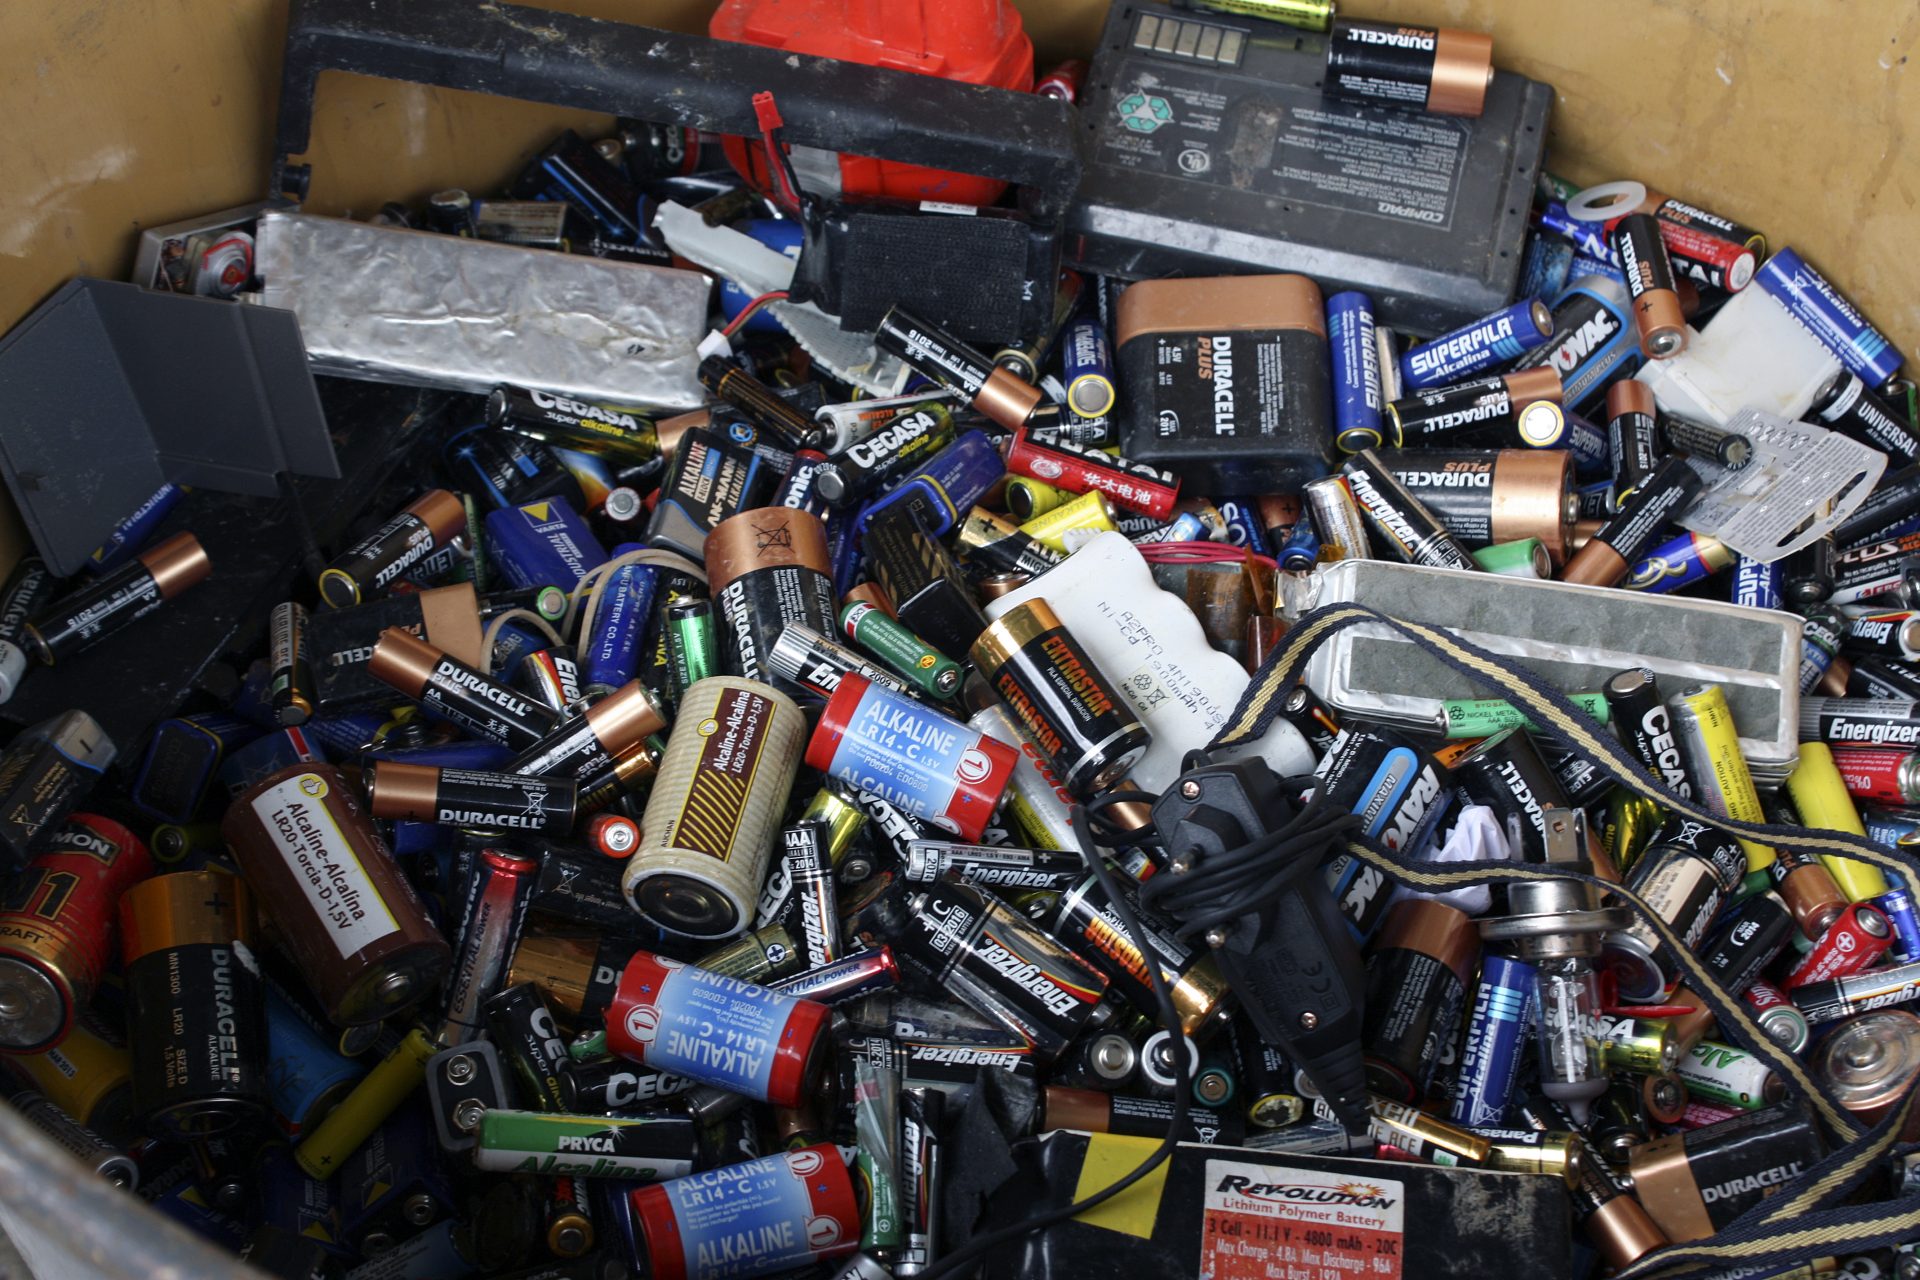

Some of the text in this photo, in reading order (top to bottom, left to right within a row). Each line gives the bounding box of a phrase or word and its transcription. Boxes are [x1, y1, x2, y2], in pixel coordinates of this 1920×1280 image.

[1348, 27, 1435, 51] DURACELL
[1377, 202, 1445, 223] COMPAQ
[1660, 207, 1692, 224] PLUS
[1664, 199, 1735, 232] DURACELL
[1619, 232, 1643, 298] DURACELL
[1638, 260, 1655, 288] PLUS
[1811, 276, 1864, 328] Alcalina
[909, 328, 934, 346] 2016
[1411, 317, 1513, 375] SUPERPILA
[1198, 337, 1213, 380] PLUS
[1359, 310, 1379, 409] SUPERPILA
[1434, 350, 1490, 378] Alcalina
[1213, 336, 1235, 435] DURACELL
[1479, 391, 1508, 407] PLUS
[544, 411, 625, 437] super alkaline
[1160, 415, 1170, 437] 2011
[1424, 401, 1509, 431] DURACELL
[1857, 400, 1917, 457] UNIVERSAL
[897, 433, 930, 458] alkaline
[680, 441, 708, 497] ALKALINE
[1398, 471, 1490, 488] DURACEL
[1445, 462, 1492, 473] PLUS
[783, 464, 814, 509] onic
[1083, 471, 1152, 506] 华太电池
[1347, 469, 1423, 550] Energizer
[408, 529, 432, 547] PLUS
[533, 522, 568, 535] VARTA
[375, 537, 433, 589] DURACELL
[67, 611, 93, 629] 2016
[599, 585, 627, 663] BATTERY CO.,LTD.
[725, 579, 760, 679] DURACELL
[333, 645, 376, 667] CELL
[678, 652, 688, 665] AA
[431, 672, 462, 695] PLUS
[438, 661, 529, 717] DURACELL
[680, 665, 690, 684] SIZE
[868, 669, 892, 688] 2009
[1040, 633, 1115, 718] EXTRASTAR
[1053, 675, 1075, 699] ESPECIAL
[1145, 652, 1199, 714] 1900mAh
[426, 688, 442, 701] AA
[864, 700, 957, 755] ALKALINE
[997, 671, 1066, 758] EXTRASTAR
[1466, 709, 1518, 719] NICKEL METAL
[1487, 714, 1521, 724] AAA SIZE
[1829, 718, 1920, 743] Energizer
[712, 690, 751, 772] Alcaline-Alcalina
[731, 696, 765, 776] LR20-Torcia-D-1,5V
[1634, 729, 1652, 765] super
[581, 741, 597, 755] AA
[906, 744, 919, 760] C
[921, 755, 941, 770] 1.5V
[838, 766, 927, 816] ALCALINE
[1714, 760, 1733, 804] CAUTION
[1507, 760, 1547, 840] URACELL
[439, 808, 543, 829] DURACELL
[660, 819, 675, 848] AUCHAN
[270, 808, 353, 930] LR20-Torcia-D-1,5V
[286, 802, 366, 921] Alcaline-Alcalina
[794, 857, 816, 871] 2014
[928, 856, 938, 881] 2014
[961, 861, 1056, 888] Energizer
[478, 902, 493, 938] POWER
[932, 899, 951, 916] C
[1740, 919, 1762, 942] 2014
[168, 952, 180, 995] MN1300
[691, 970, 783, 1005] ALCALINE
[823, 962, 862, 982] POWER
[977, 938, 1080, 1016] Energizer
[172, 1006, 183, 1036] LR20
[211, 948, 241, 1082] DURACELL
[677, 1013, 698, 1027] 1.5V
[700, 1021, 714, 1038] C
[176, 1048, 187, 1074] SIZE
[207, 1034, 220, 1081] ALKALINE
[523, 1032, 549, 1075] super
[666, 1030, 764, 1080] ALKALINE
[911, 1045, 1022, 1073] Energizer
[1451, 981, 1493, 1120] SUPERPILA
[1470, 1022, 1497, 1100] Alcalina
[558, 1135, 616, 1154] PRYCA
[516, 1155, 660, 1180] Alcalina
[677, 1158, 776, 1193] ALCALINE
[903, 1116, 923, 1217] Energizer
[1701, 1161, 1802, 1204] DURACELL
[738, 1181, 753, 1195] C
[756, 1178, 778, 1191] 1.5V
[1216, 1174, 1396, 1210] REV-OLUTION
[1223, 1197, 1385, 1230] Lithium Polymer Battery
[698, 1220, 795, 1268] ALKALINE
[1208, 1218, 1216, 1233] 3
[1220, 1219, 1242, 1236] Cell
[1256, 1224, 1279, 1241] 11.1
[1337, 1234, 1363, 1250] mAh
[1376, 1238, 1399, 1256] 20C
[1216, 1238, 1391, 1274] Max Charge 4.8A Max Discharge 96A
[1266, 1263, 1310, 1280] Max Burst
